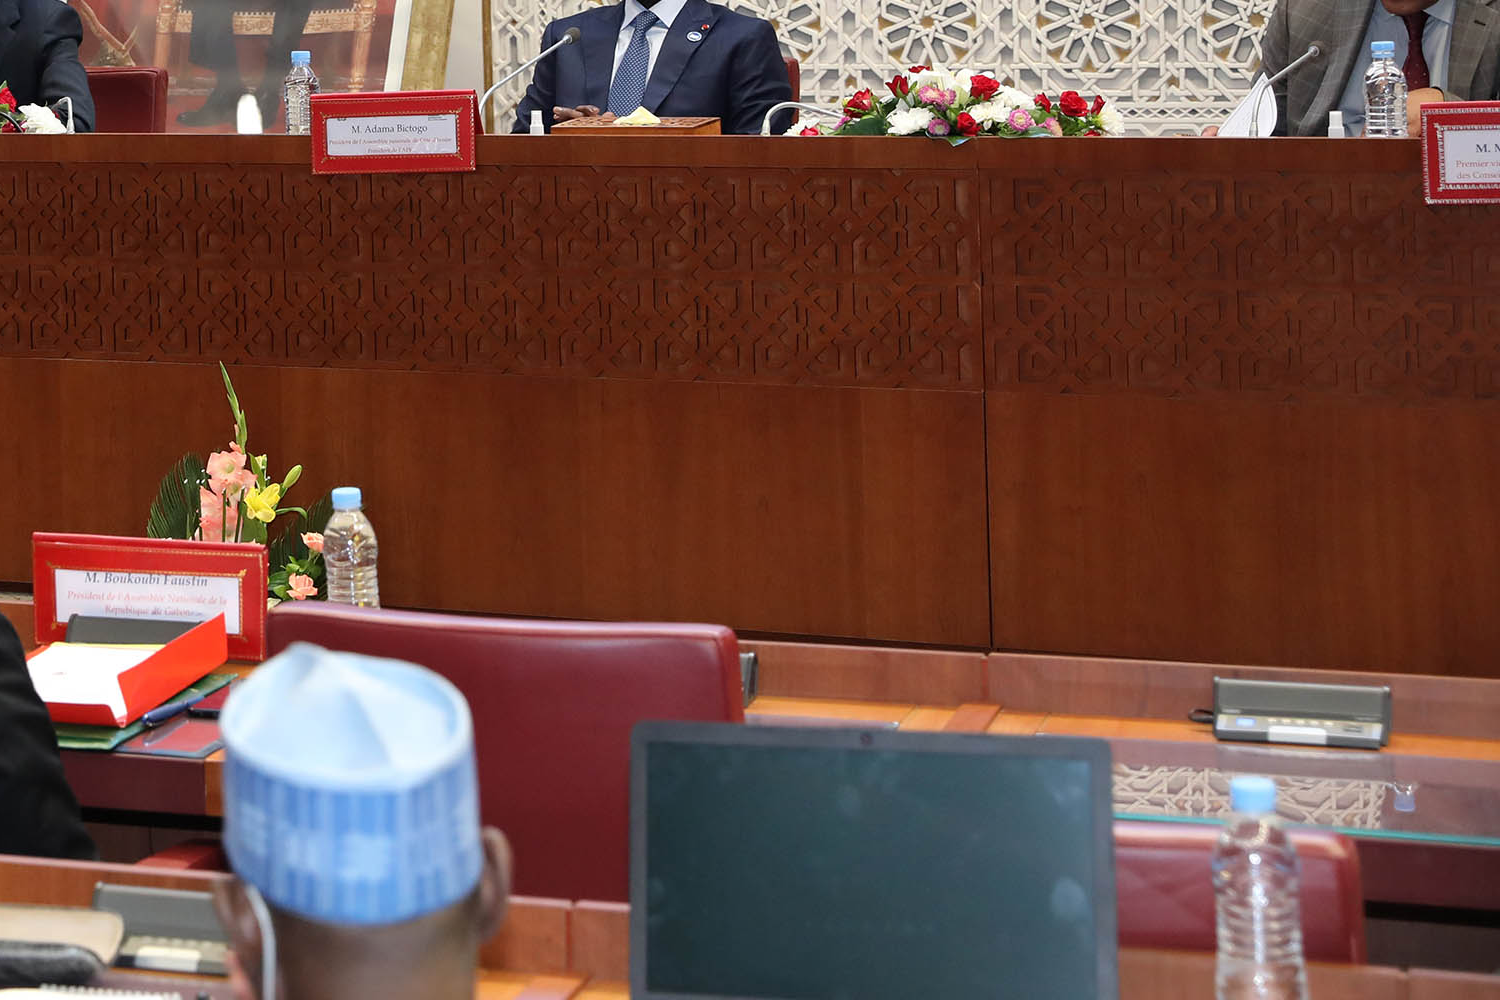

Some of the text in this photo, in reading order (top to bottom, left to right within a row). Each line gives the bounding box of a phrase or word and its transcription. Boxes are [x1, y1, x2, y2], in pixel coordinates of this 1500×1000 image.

[351, 124, 428, 134] M. Adama Bictogo
[1475, 144, 1491, 153] M.
[1455, 160, 1488, 168] Premier
[84, 572, 208, 587] M. Boukoubi Faustin
